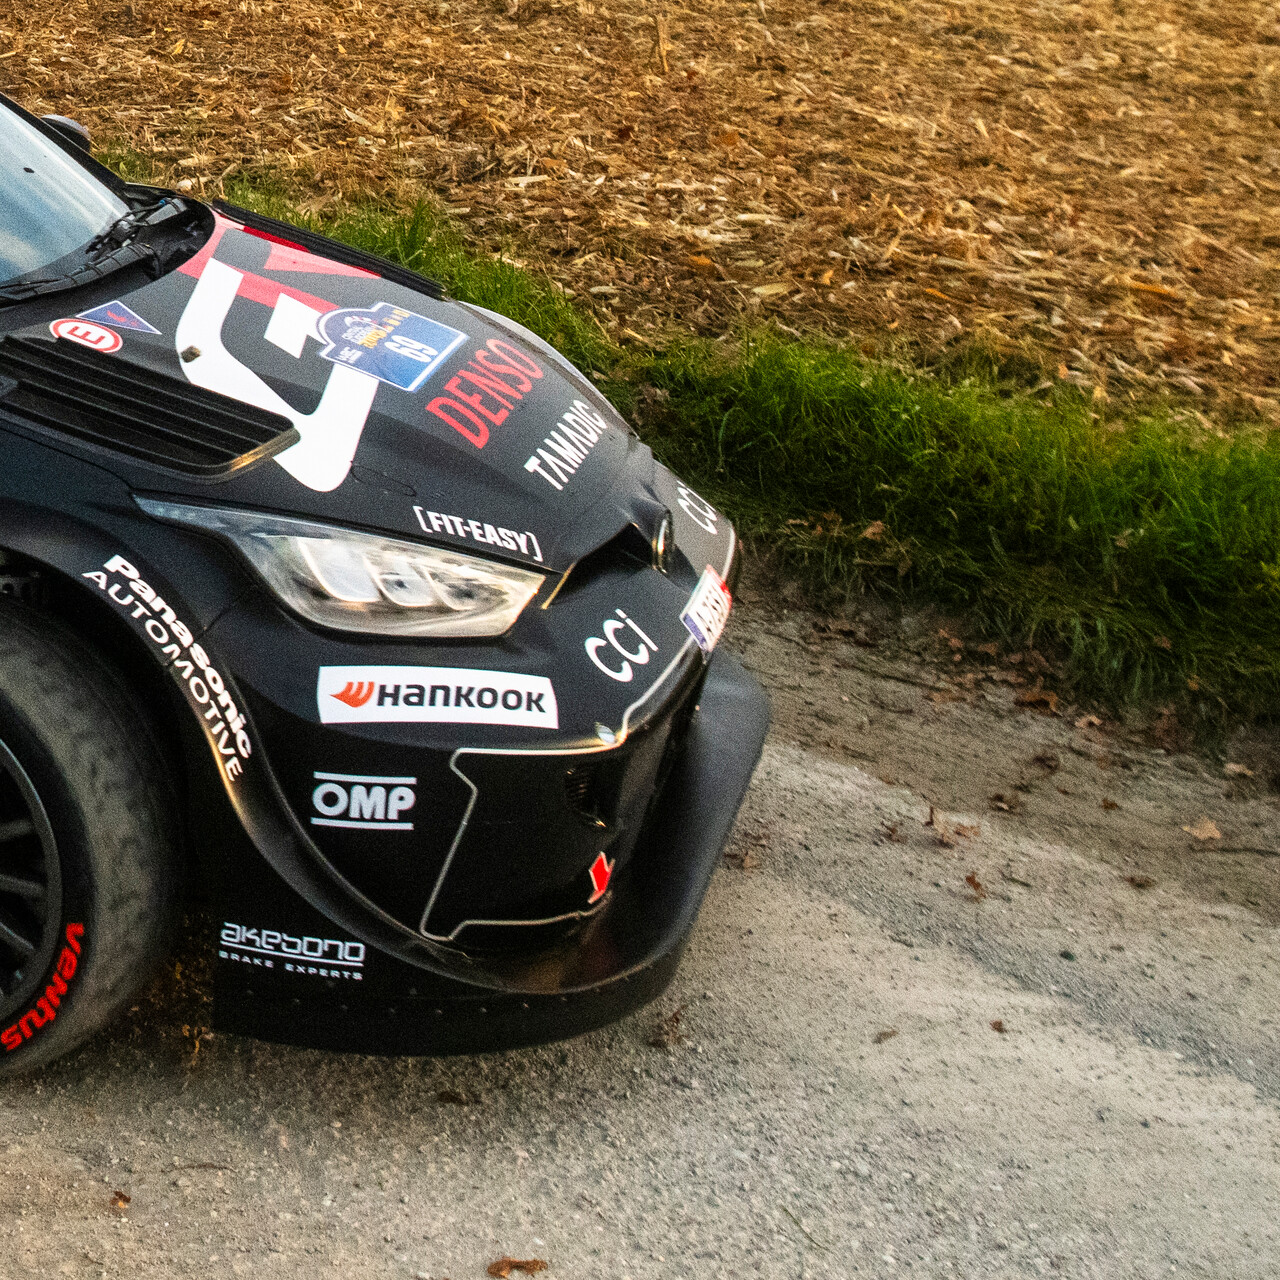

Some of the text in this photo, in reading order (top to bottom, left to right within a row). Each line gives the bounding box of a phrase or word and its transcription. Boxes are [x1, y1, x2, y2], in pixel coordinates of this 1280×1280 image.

[384, 335, 438, 363] 69
[425, 337, 546, 450] DENSO
[524, 399, 607, 491] TAMADIC
[81, 571, 244, 782] AUTOMOTIVE
[103, 554, 253, 759] Panasonic
[312, 781, 417, 821] OMP
[218, 950, 363, 982] BRAKE EXPERTS
[220, 921, 366, 963] akebono
